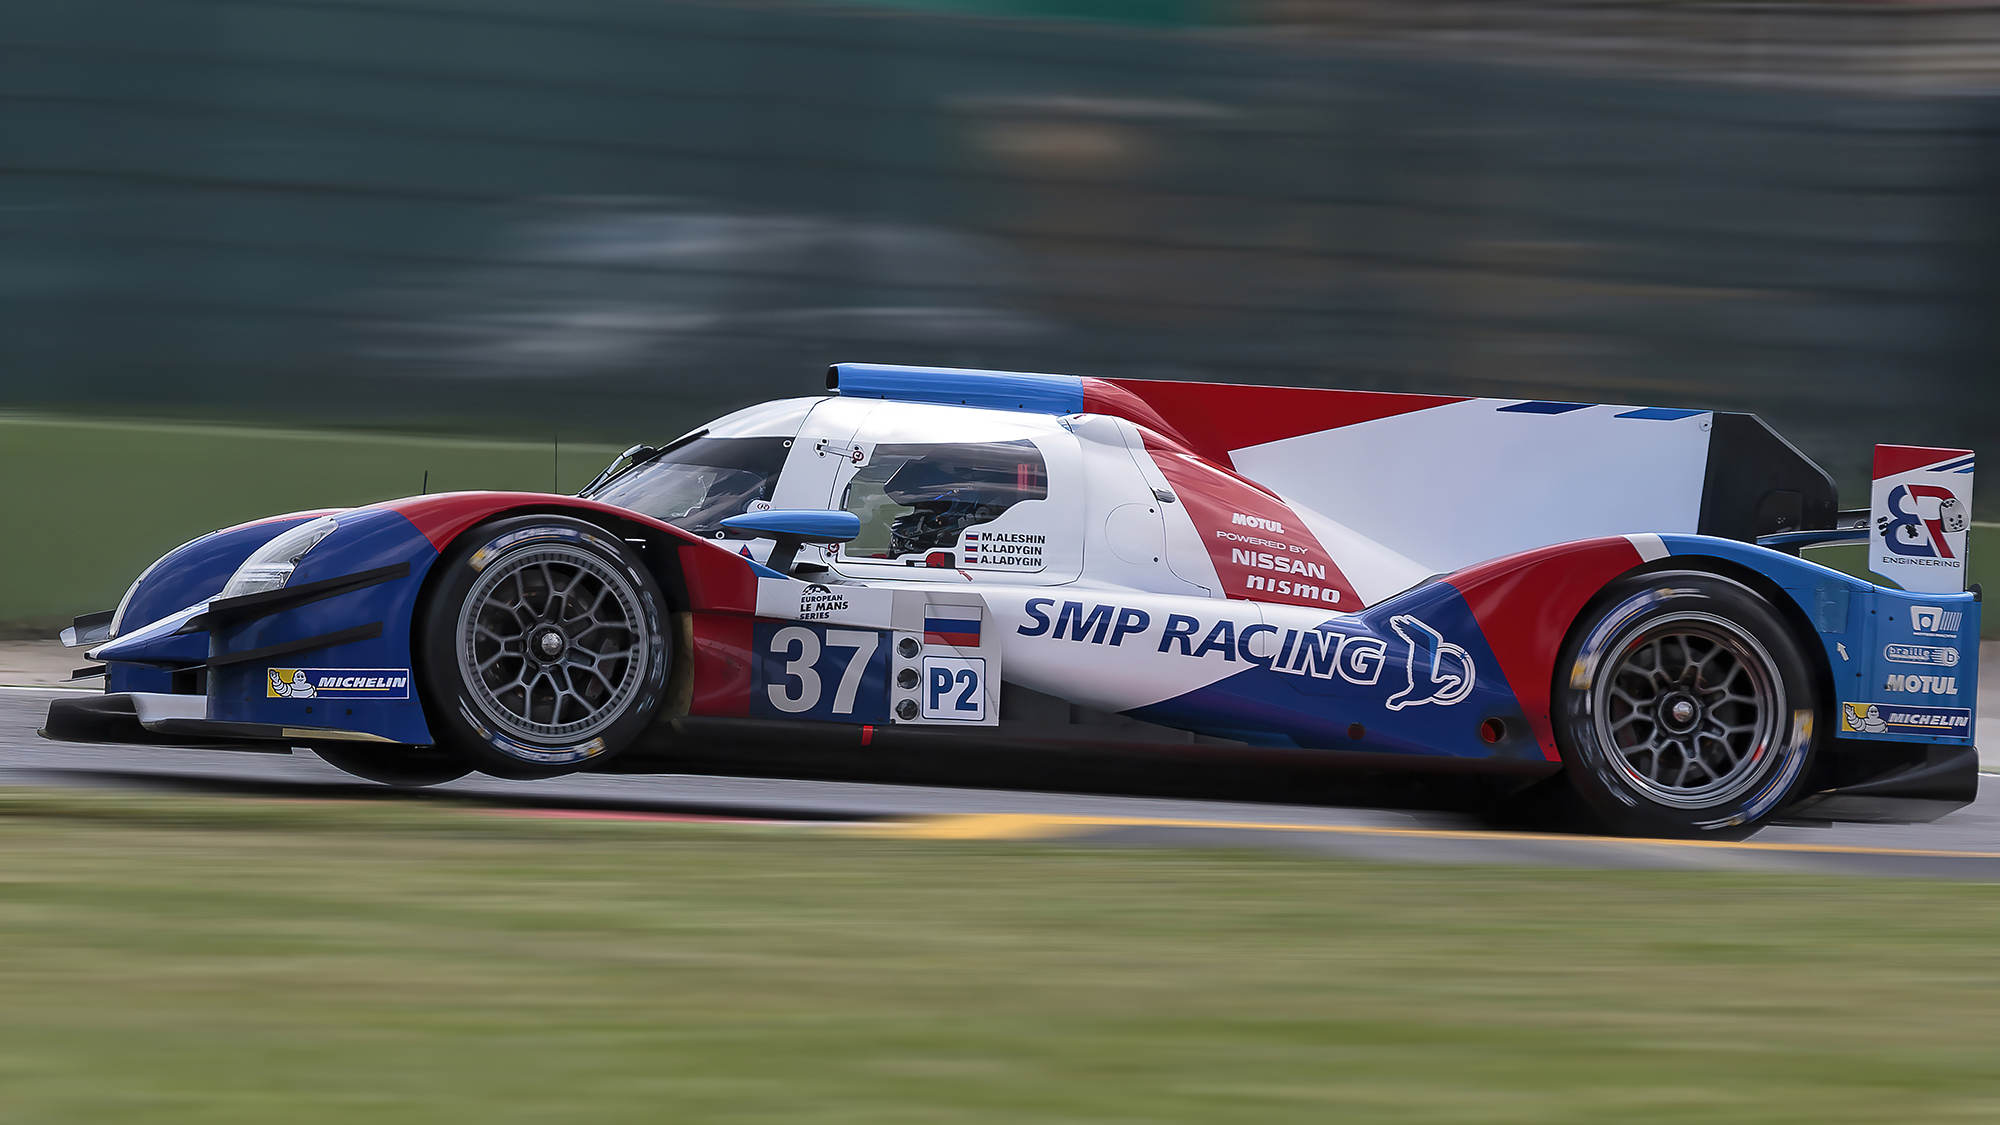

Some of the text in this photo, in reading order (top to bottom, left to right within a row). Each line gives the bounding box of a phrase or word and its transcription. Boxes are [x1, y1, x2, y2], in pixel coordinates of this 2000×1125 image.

[1232, 513, 1284, 534] MOTUL
[981, 532, 1046, 544] M.ALESHIN
[1216, 530, 1309, 555] POWERED BY
[981, 544, 1042, 556] K.LADYGIN
[980, 556, 1042, 567] A.LADYGIN
[1232, 547, 1326, 580] NISSAN
[1883, 556, 1961, 568] ENGINEERING
[1246, 574, 1341, 603] nismo
[801, 594, 843, 603] EUROPEAN
[800, 601, 849, 612] LE MANS
[800, 612, 830, 620] SERIES
[1017, 597, 1387, 685] SMP RACING
[1889, 646, 1931, 657] braille
[767, 626, 880, 714] 37
[318, 677, 407, 688] MICHELIN
[930, 667, 978, 711] P2
[1888, 674, 1959, 695] MOTUL
[1887, 712, 1969, 727] MICHELIN
